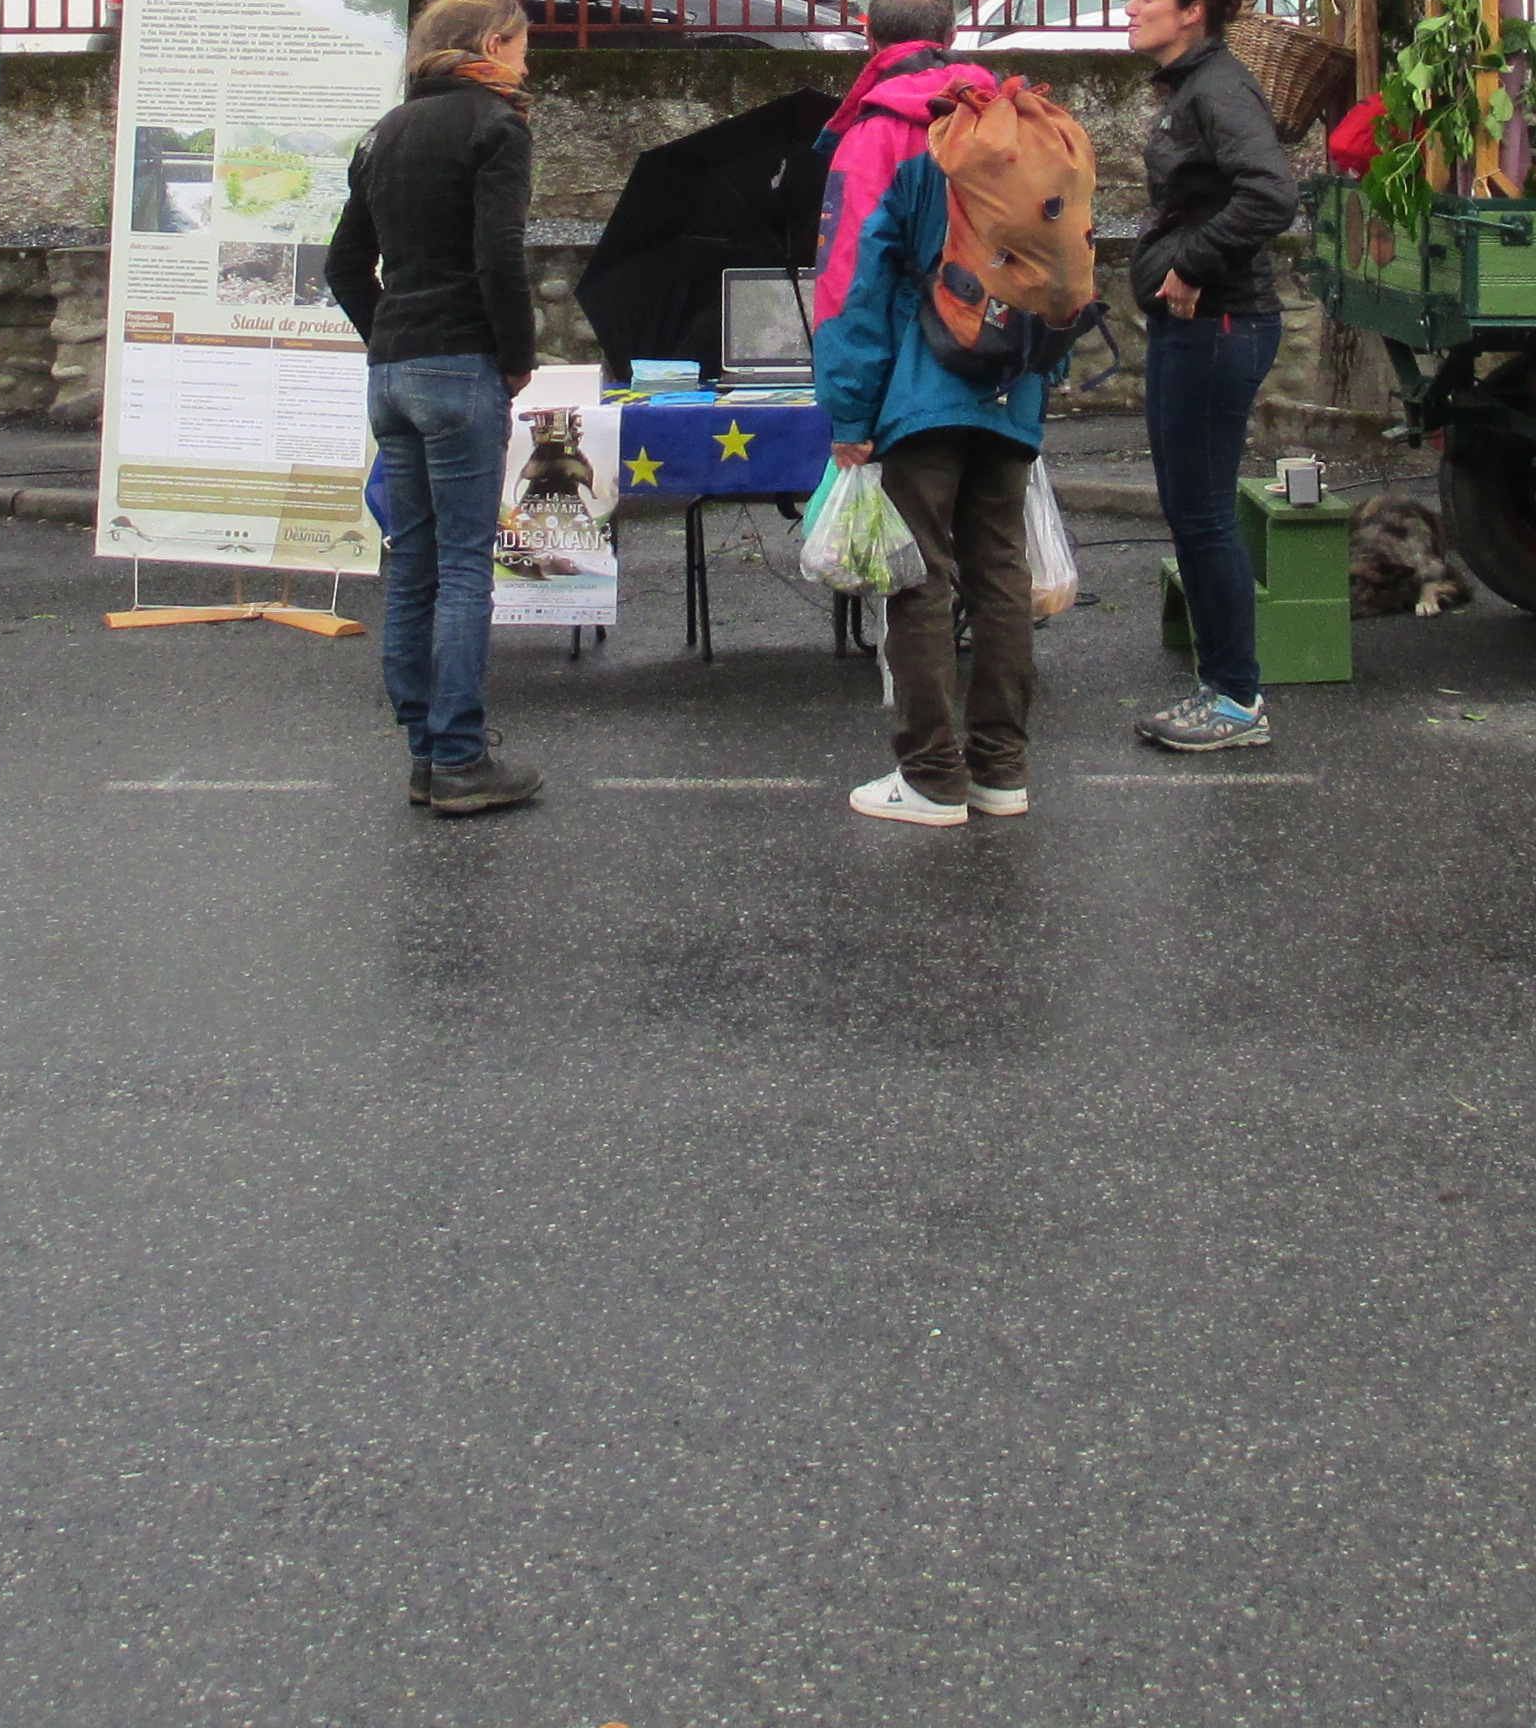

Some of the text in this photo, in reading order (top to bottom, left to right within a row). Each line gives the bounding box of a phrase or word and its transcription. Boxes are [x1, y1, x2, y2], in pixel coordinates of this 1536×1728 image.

[230, 313, 360, 336] Statut de protectio
[546, 492, 560, 502] LA
[521, 503, 585, 514] CARAVANE
[283, 528, 332, 544] Desman
[503, 529, 600, 550] DESMAN
